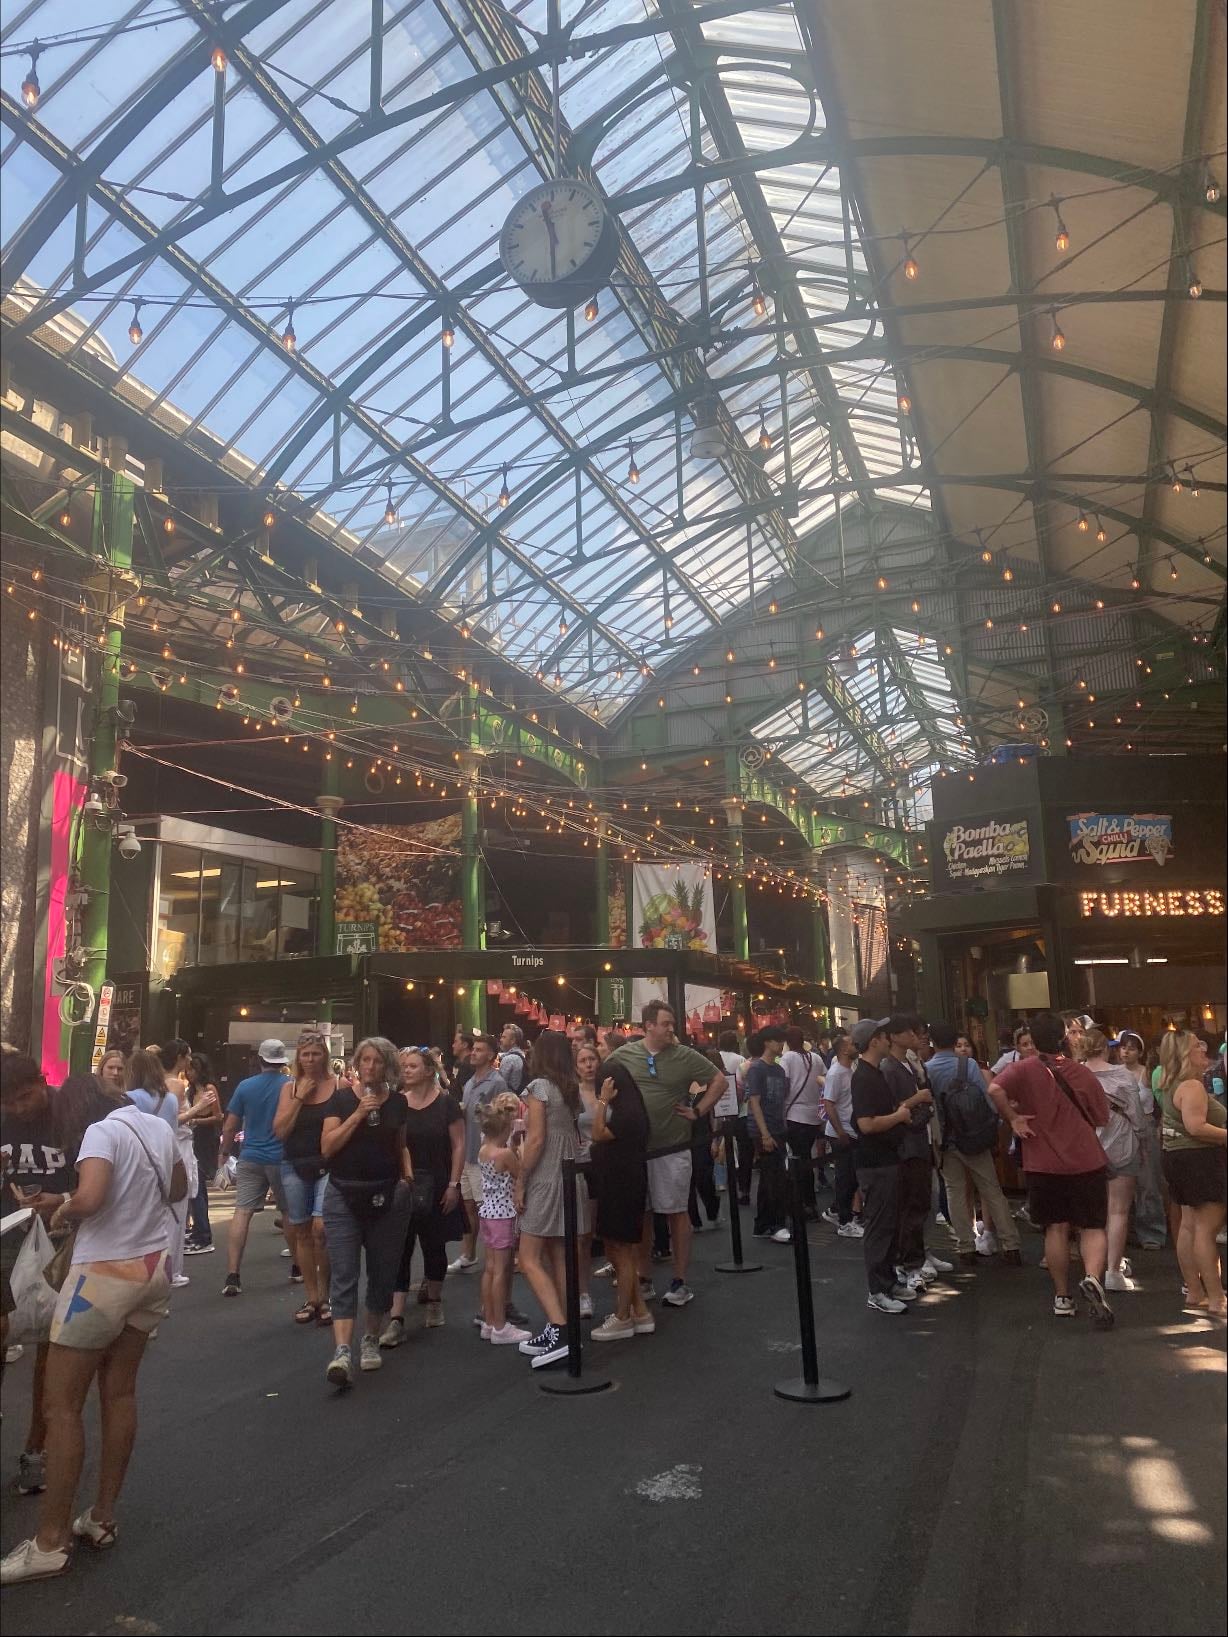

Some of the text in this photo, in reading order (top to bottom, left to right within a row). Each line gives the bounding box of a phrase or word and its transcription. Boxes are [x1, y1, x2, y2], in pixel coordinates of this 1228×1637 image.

[953, 821, 1010, 842] Bomba
[1077, 818, 1168, 837] Salt & Pepper
[954, 839, 1004, 860] Paella
[1072, 836, 1140, 864] Squid
[1081, 890, 1225, 916] FURNESS
[337, 923, 375, 933] TURNIPS
[511, 955, 544, 968] Turnips
